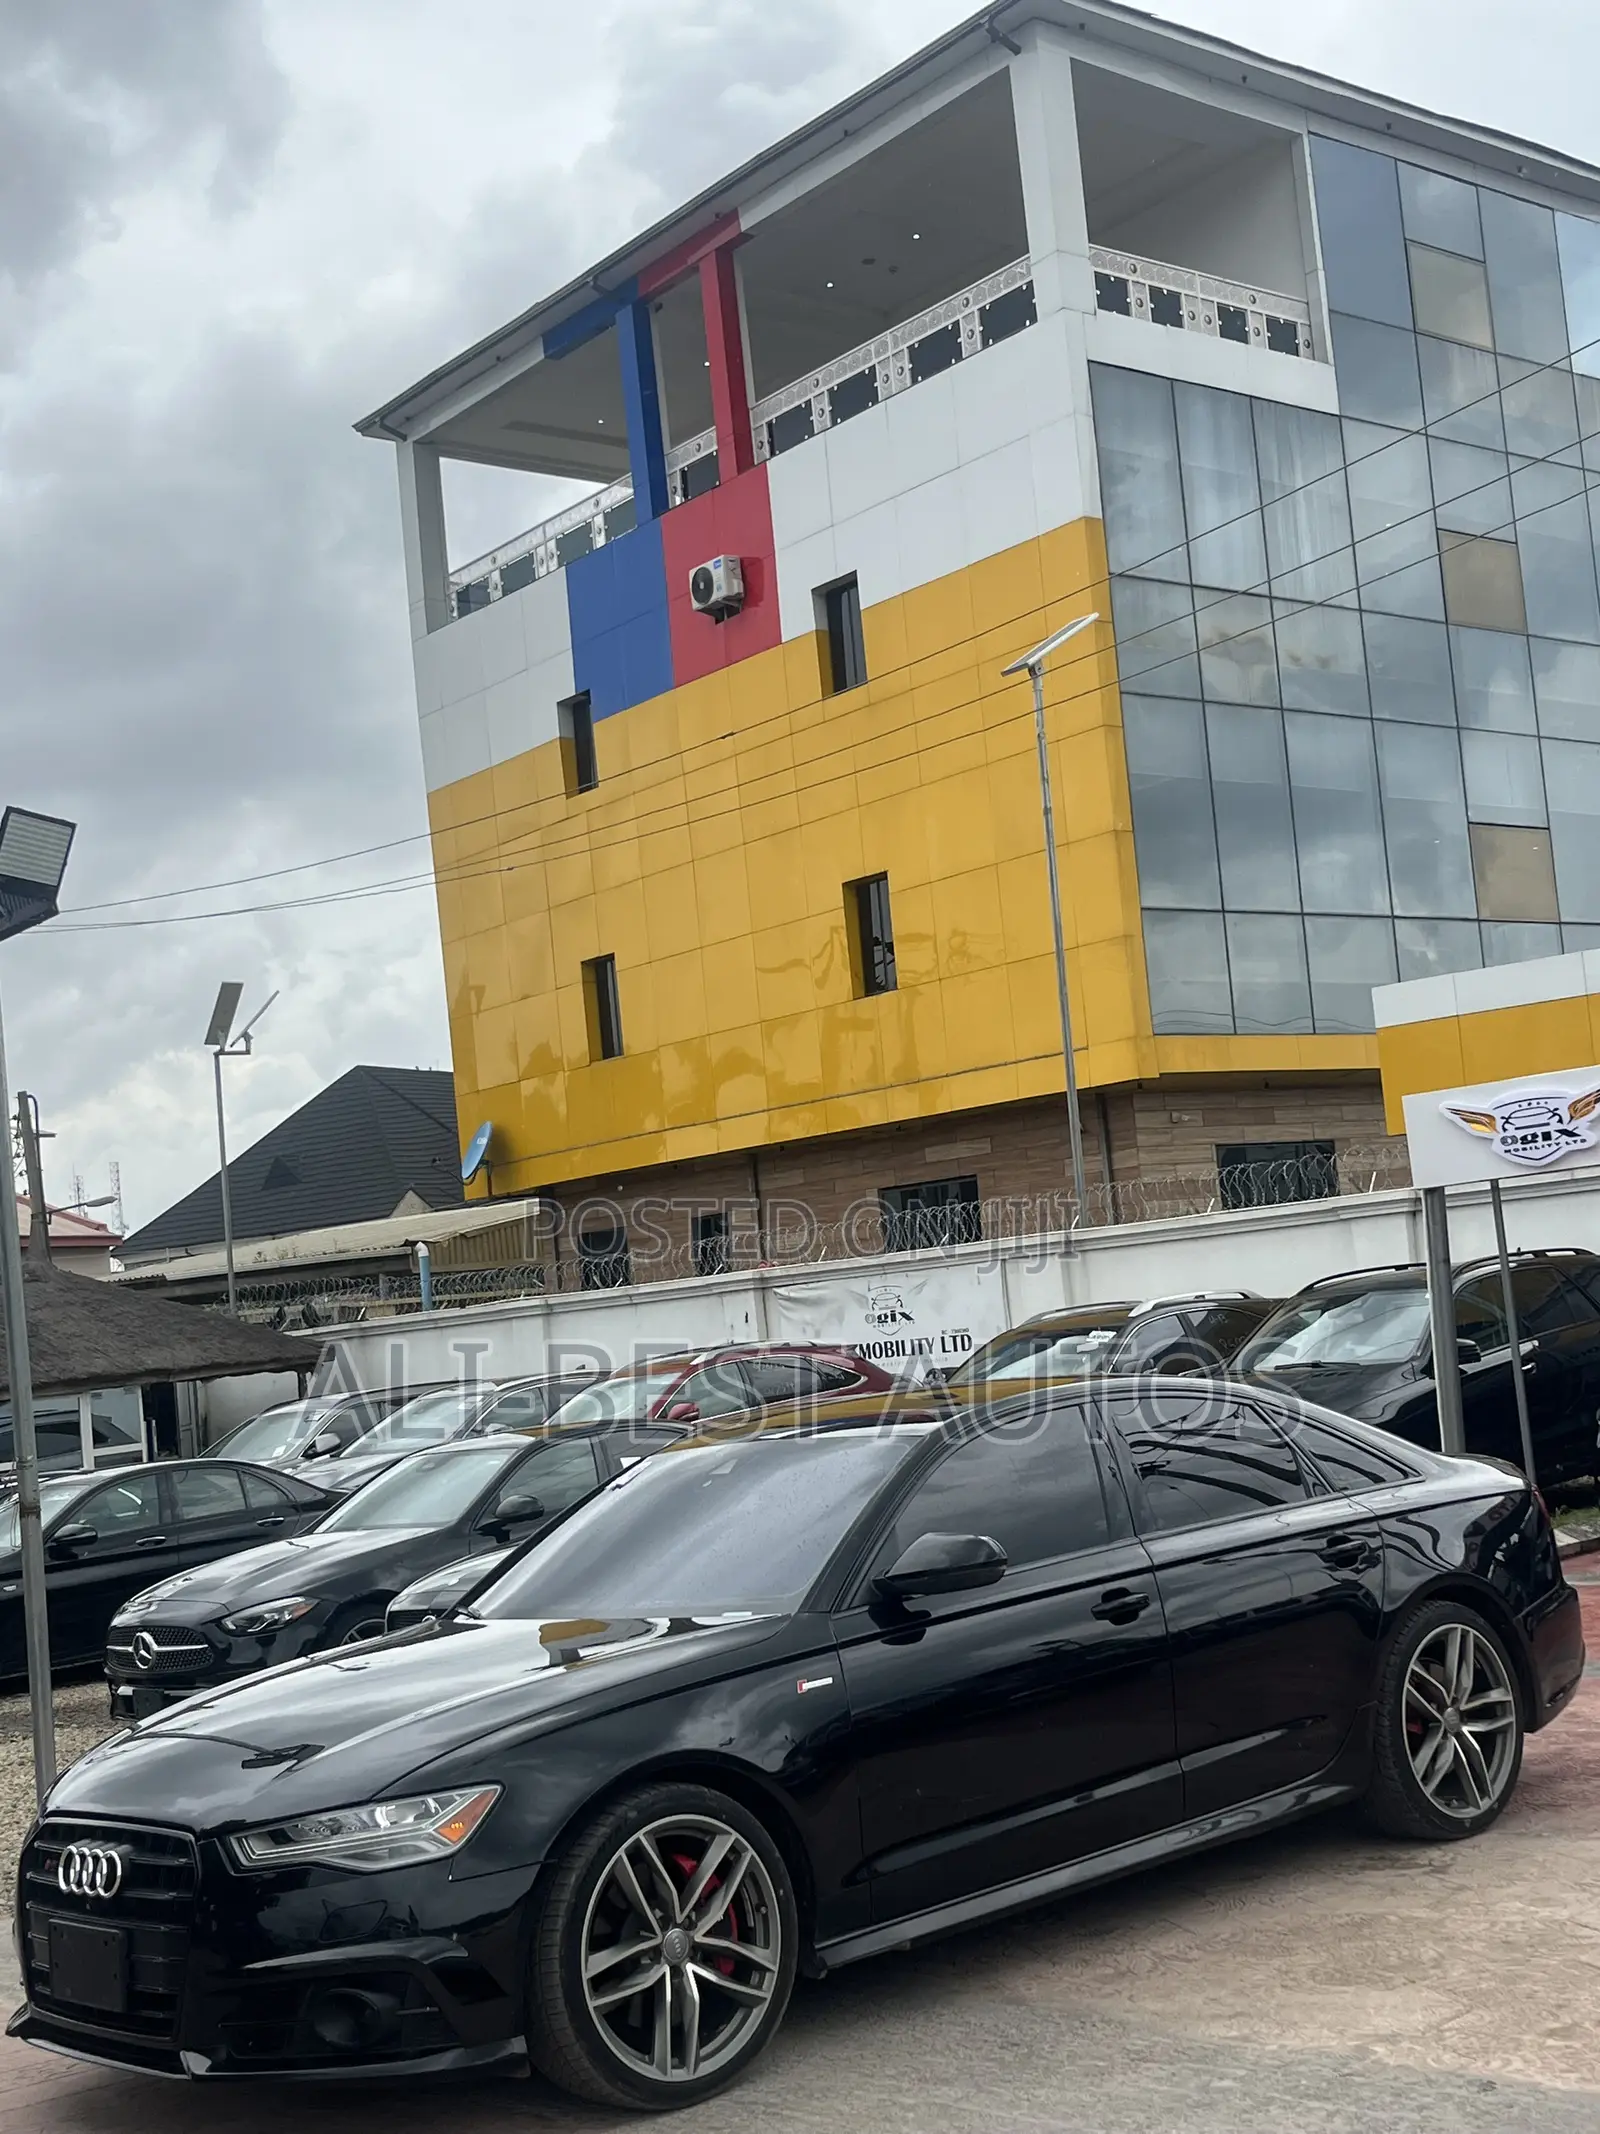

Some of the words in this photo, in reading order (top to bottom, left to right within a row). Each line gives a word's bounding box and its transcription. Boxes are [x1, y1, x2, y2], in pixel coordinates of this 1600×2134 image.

[1504, 1142, 1562, 1153] MOBILITY
[1565, 1138, 1587, 1146] LTD
[859, 1337, 935, 1359] MOBILITY
[941, 1334, 972, 1353] LTD
